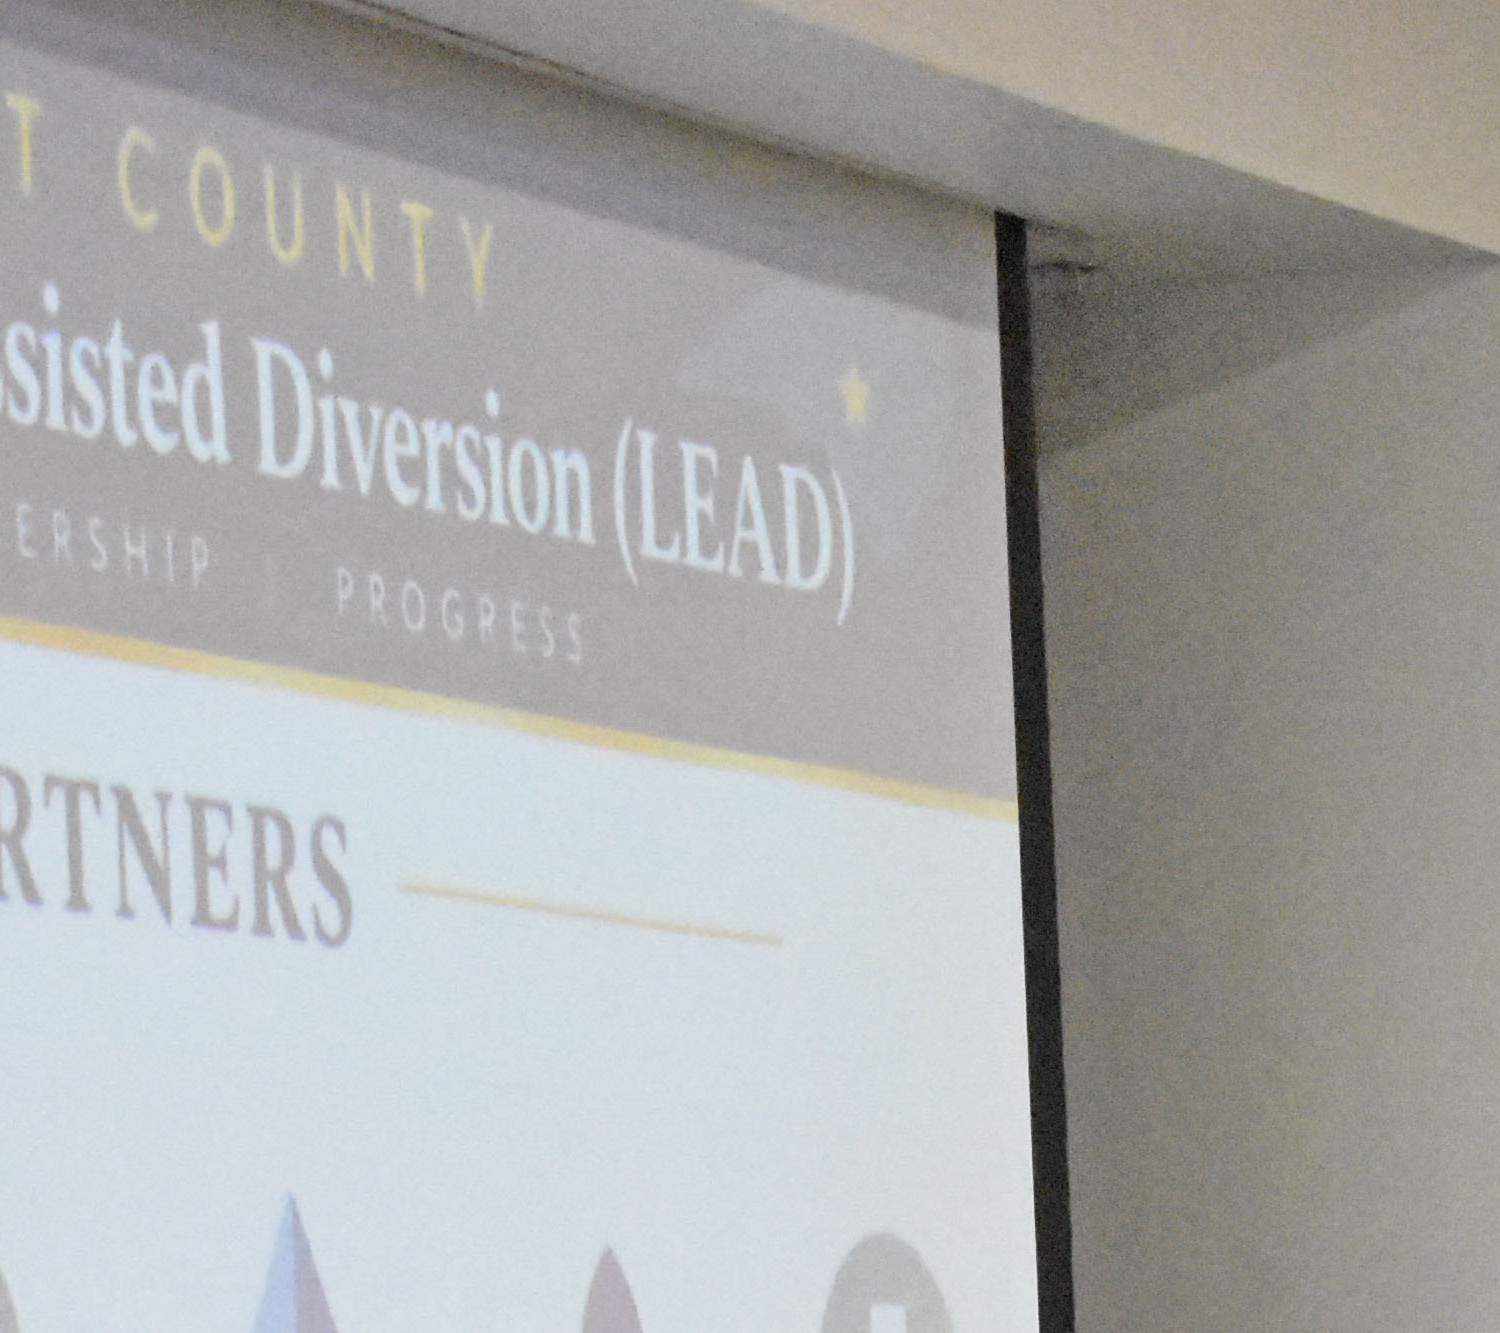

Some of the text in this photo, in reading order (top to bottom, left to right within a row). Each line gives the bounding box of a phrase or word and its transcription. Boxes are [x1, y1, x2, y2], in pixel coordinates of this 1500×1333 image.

[119, 126, 493, 308] COUNTY
[250, 336, 595, 545] Diversion
[613, 417, 855, 626] (LEAD)
[337, 566, 584, 664] PROGRESS
